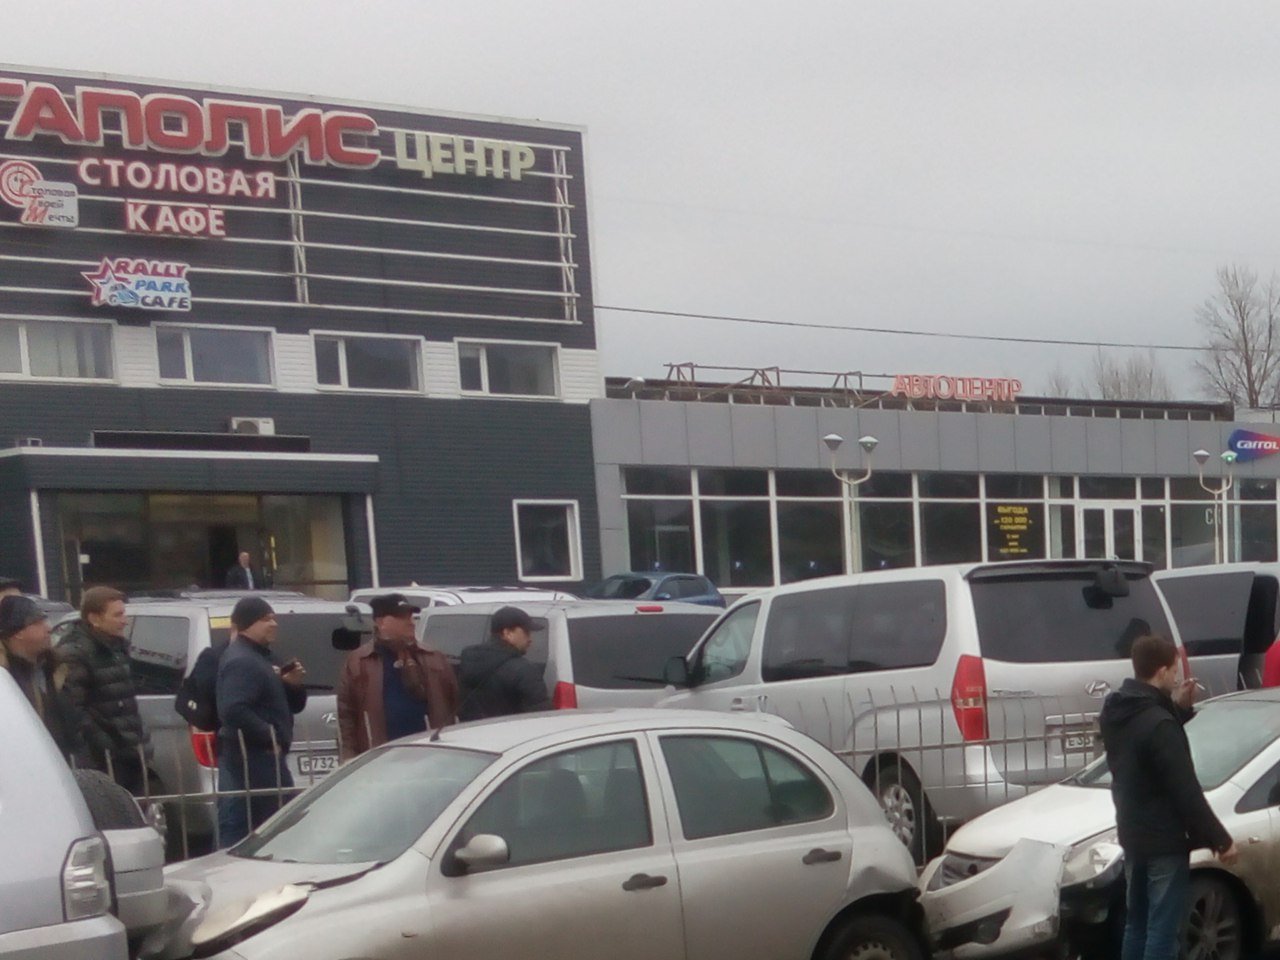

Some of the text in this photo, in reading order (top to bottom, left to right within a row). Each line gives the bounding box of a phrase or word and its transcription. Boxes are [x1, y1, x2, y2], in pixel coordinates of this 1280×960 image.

[395, 131, 535, 181] ЦЕНТР
[79, 158, 276, 198] СТОЛОВАЯ
[126, 203, 226, 236] КАФЕ
[114, 260, 188, 279] RALLY
[135, 279, 189, 293] PARK
[140, 295, 190, 309] CAFE
[892, 374, 1022, 402] АВТОЦЕНТР
